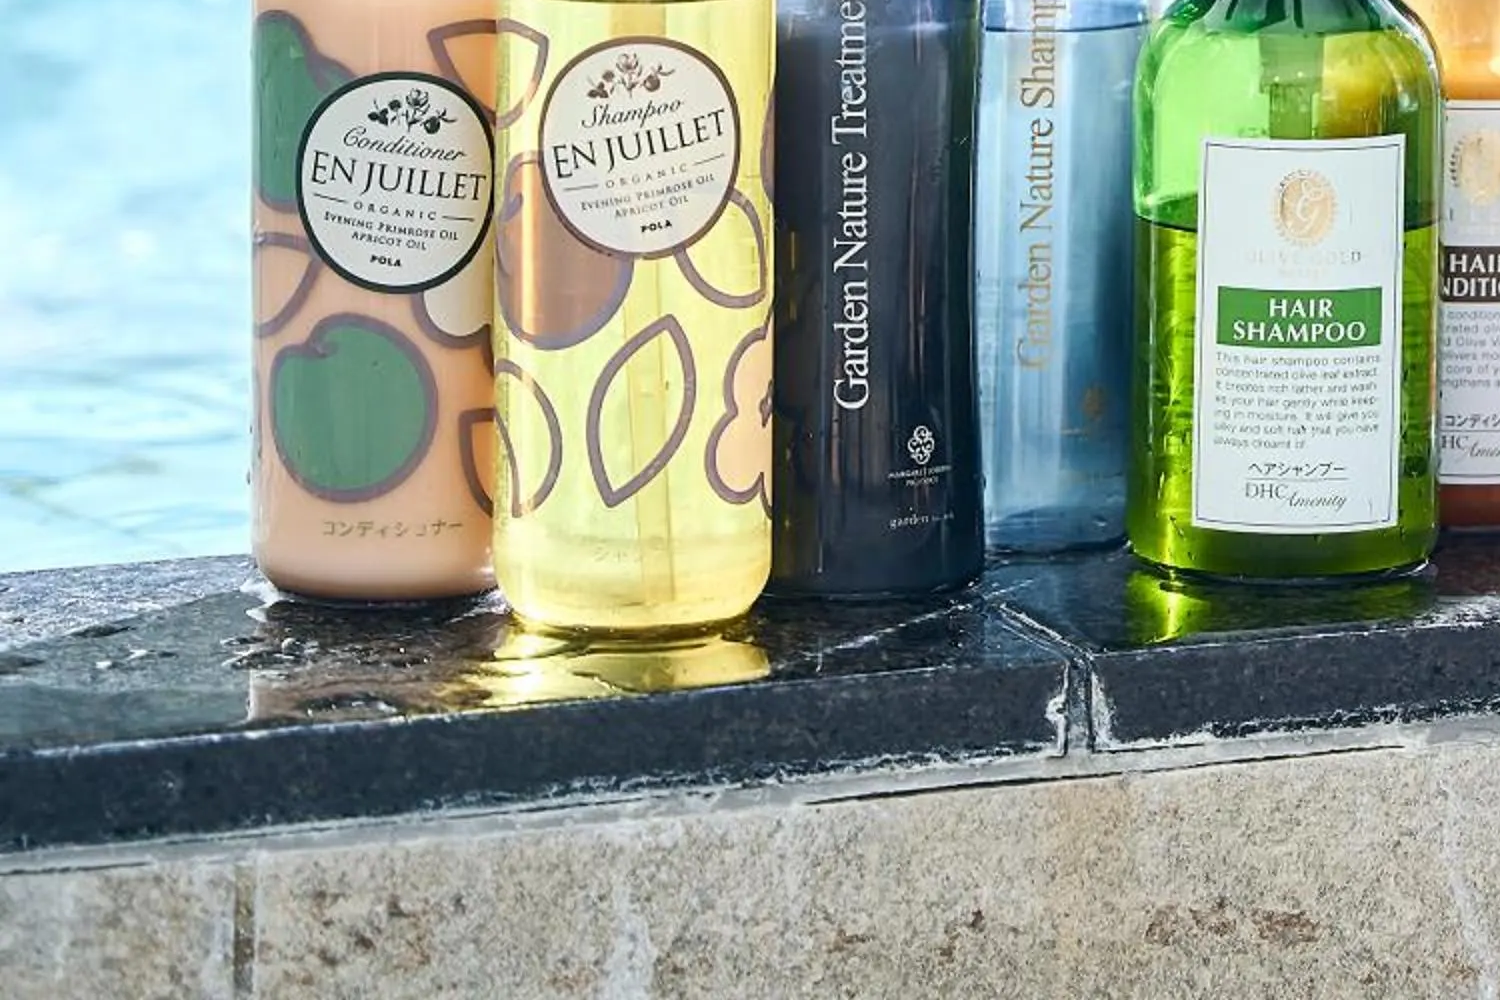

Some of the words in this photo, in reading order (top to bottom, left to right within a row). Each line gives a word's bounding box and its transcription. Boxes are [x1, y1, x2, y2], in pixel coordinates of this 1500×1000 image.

[581, 98, 684, 129] Shampoo
[343, 125, 468, 161] Conditioner
[552, 140, 597, 179] EN
[604, 109, 725, 173] JUILLET
[311, 150, 357, 185] EN
[360, 160, 487, 201] JUILLET
[605, 162, 688, 189] ORGANIC
[1019, 117, 1053, 233] Nature
[353, 201, 437, 221] ORGANIC
[833, 151, 868, 272] Nature
[640, 219, 673, 234] POLA
[369, 254, 402, 267] POLA
[1269, 298, 1333, 318] HAIR
[1233, 320, 1366, 343] SHAMPOO
[833, 280, 869, 410] Garden
[1441, 435, 1469, 449] HC
[1247, 462, 1346, 477] ヘアシャンプー
[1245, 483, 1288, 500] DHC
[322, 518, 464, 539] コンディショナー
